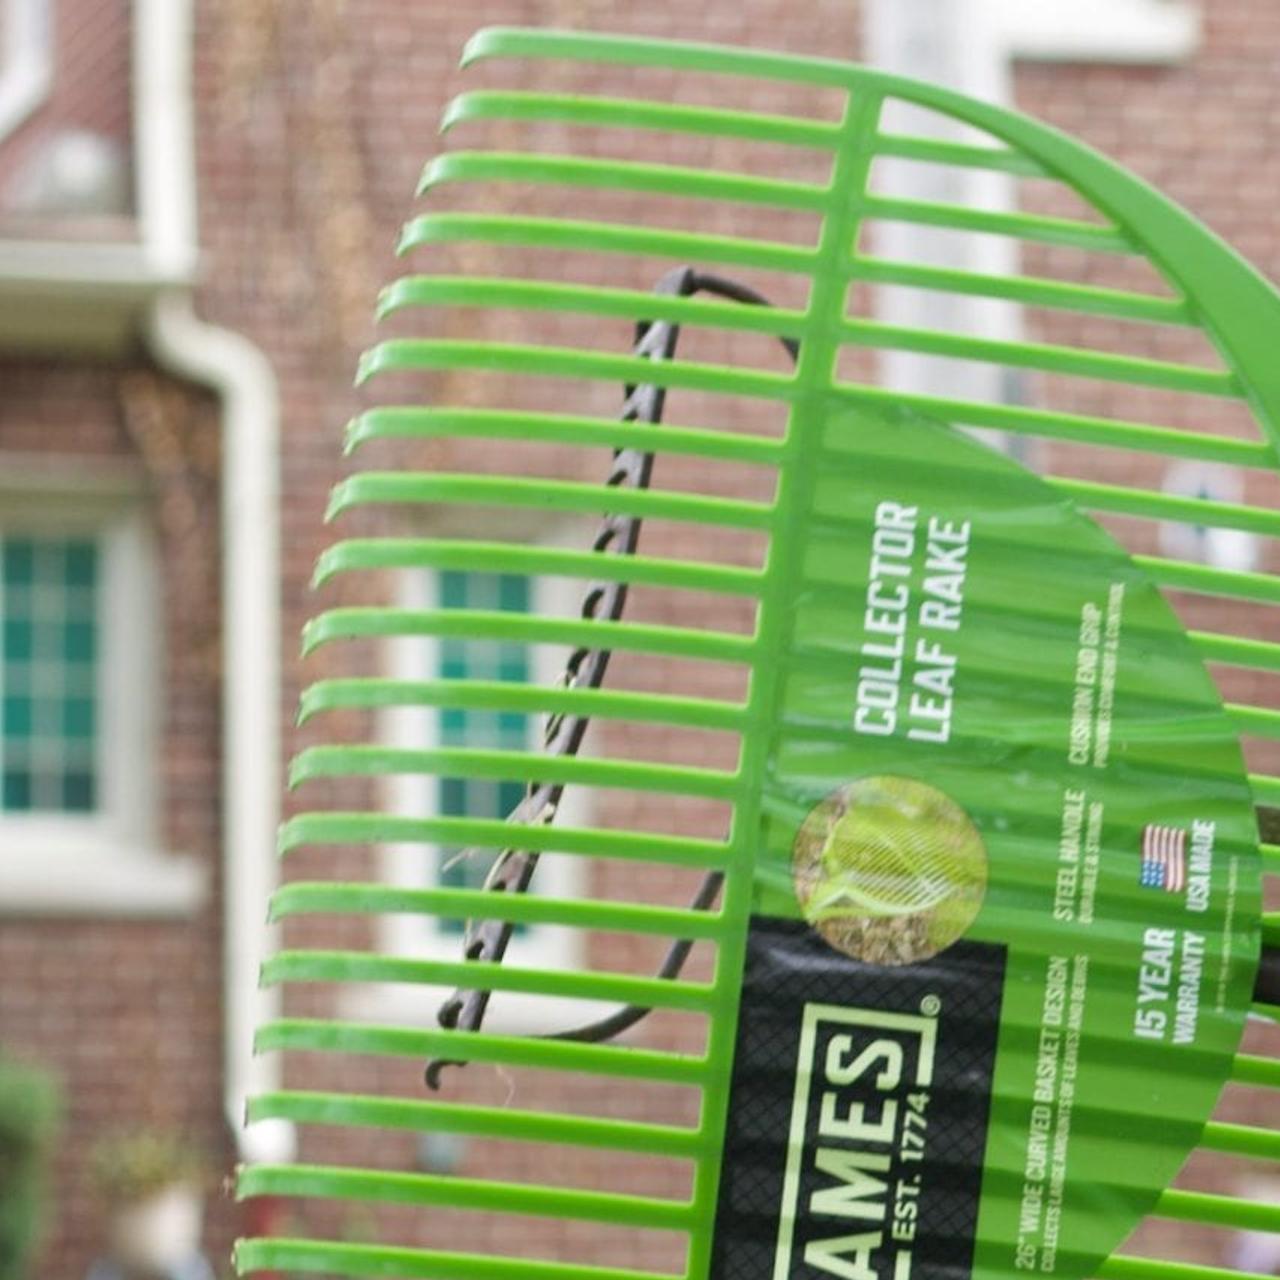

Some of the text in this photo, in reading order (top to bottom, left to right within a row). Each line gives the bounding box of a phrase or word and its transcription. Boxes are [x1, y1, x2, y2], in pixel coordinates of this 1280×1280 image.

[854, 501, 919, 735] COLLECTOR
[907, 515, 972, 742] LEAF RAKE
[1068, 602, 1103, 765] CUSHION END GRIP
[1053, 787, 1086, 921] STEEL HANDLE
[1186, 818, 1216, 912] USA MADE
[1042, 955, 1069, 1026] DESIGN
[1133, 926, 1177, 1040] 15 YEAR
[1172, 930, 1206, 1044] WARRANTY
[1034, 1027, 1061, 1102] BASKET
[1041, 954, 1089, 1272] COLLECTS LARGE AMOUNTS OF LEAVES AND DEBRIS
[891, 1092, 931, 1241] EST. 1774
[1025, 1105, 1052, 1181] CURVED
[1019, 1183, 1044, 1232] WIDE
